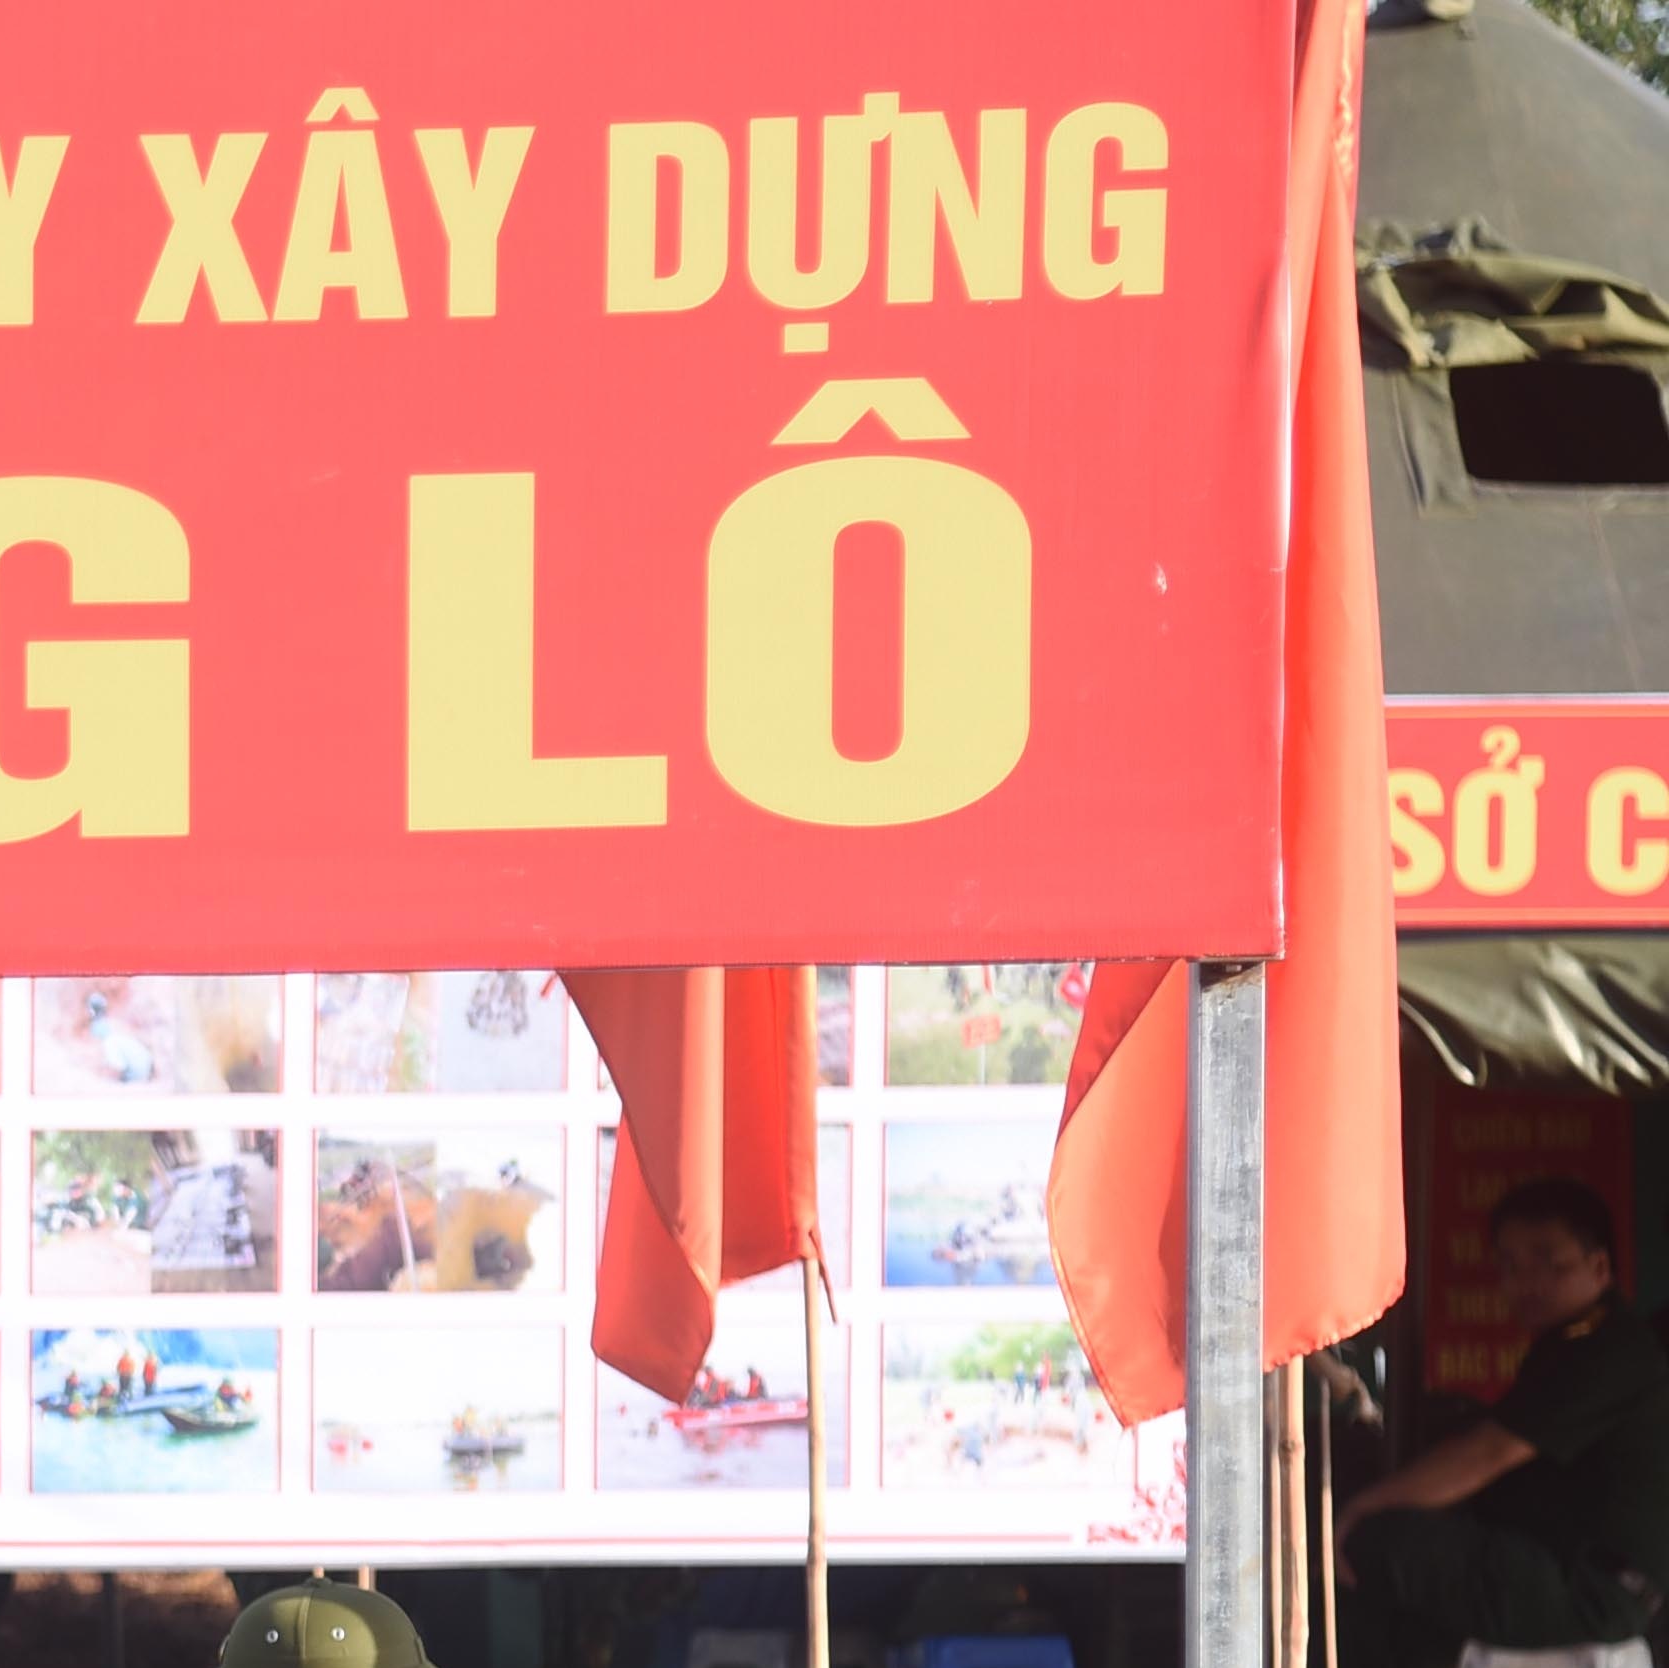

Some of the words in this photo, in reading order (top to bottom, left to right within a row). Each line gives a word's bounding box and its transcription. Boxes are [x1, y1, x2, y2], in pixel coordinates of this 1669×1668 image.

[134, 86, 536, 326] XÂY
[605, 91, 1169, 354] DỰNG
[406, 377, 1033, 833] LÔ
[1388, 724, 1545, 897] SỞ
